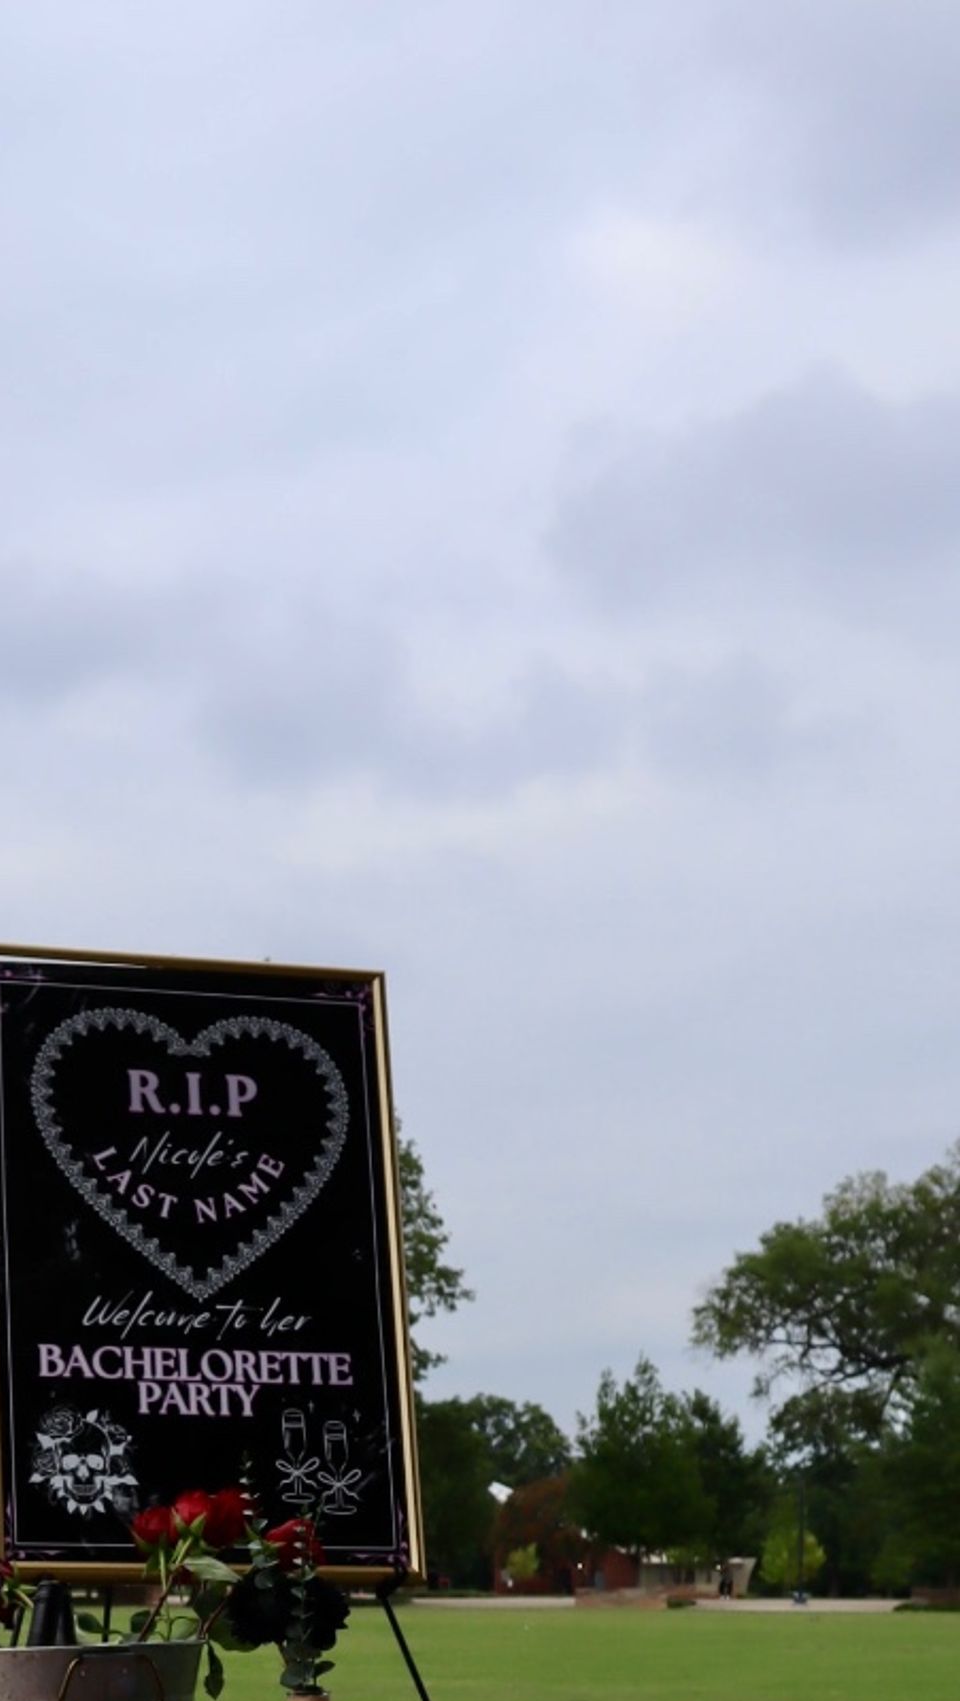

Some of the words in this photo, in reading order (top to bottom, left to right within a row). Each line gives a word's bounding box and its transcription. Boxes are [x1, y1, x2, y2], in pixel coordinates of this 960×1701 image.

[127, 1068, 259, 1118] R.I.P
[129, 1130, 249, 1180] Nicole's
[92, 1145, 179, 1219] LAST
[194, 1153, 286, 1224] NAME
[81, 1289, 212, 1341] Welcome
[259, 1296, 311, 1338] her
[37, 1343, 354, 1387] BACHELORETTE
[136, 1380, 262, 1418] PARTY
